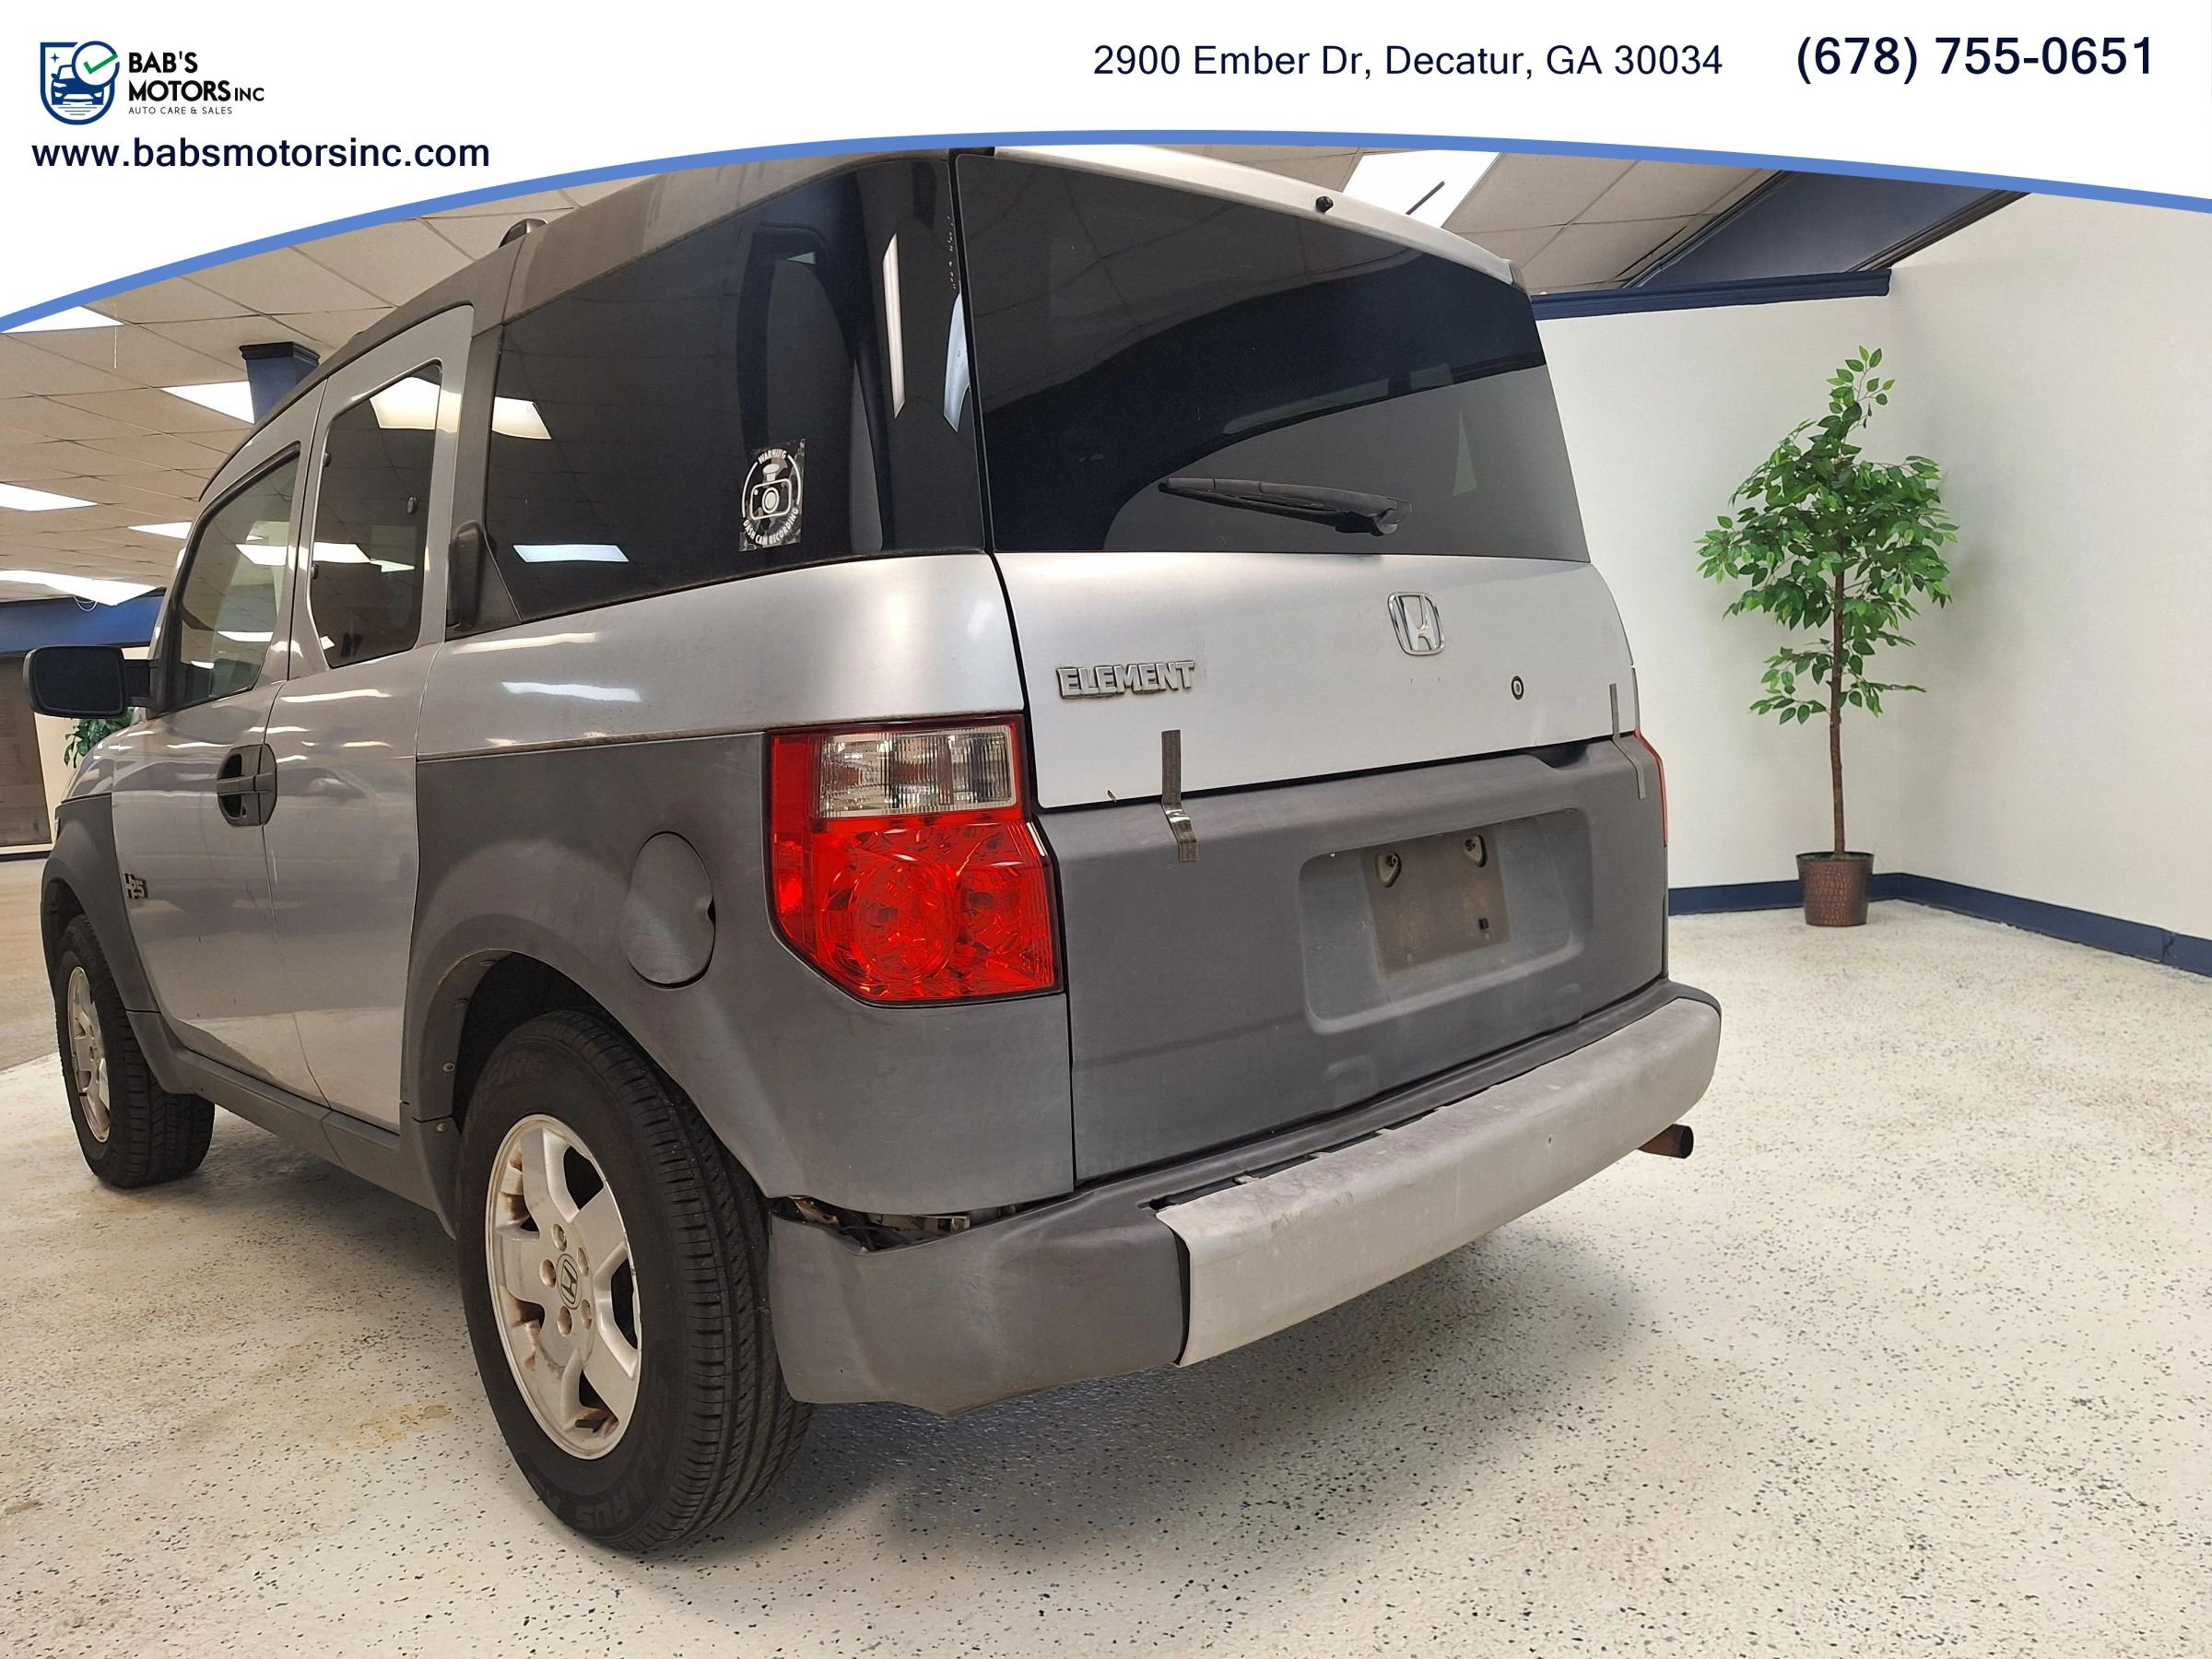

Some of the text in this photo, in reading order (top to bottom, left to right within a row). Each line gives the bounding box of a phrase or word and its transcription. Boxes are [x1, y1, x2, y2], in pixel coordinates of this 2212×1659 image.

[759, 449, 786, 464] WARNING
[743, 508, 799, 546] DASH CAM RECORDING
[1056, 660, 1194, 699] ELEMENT
